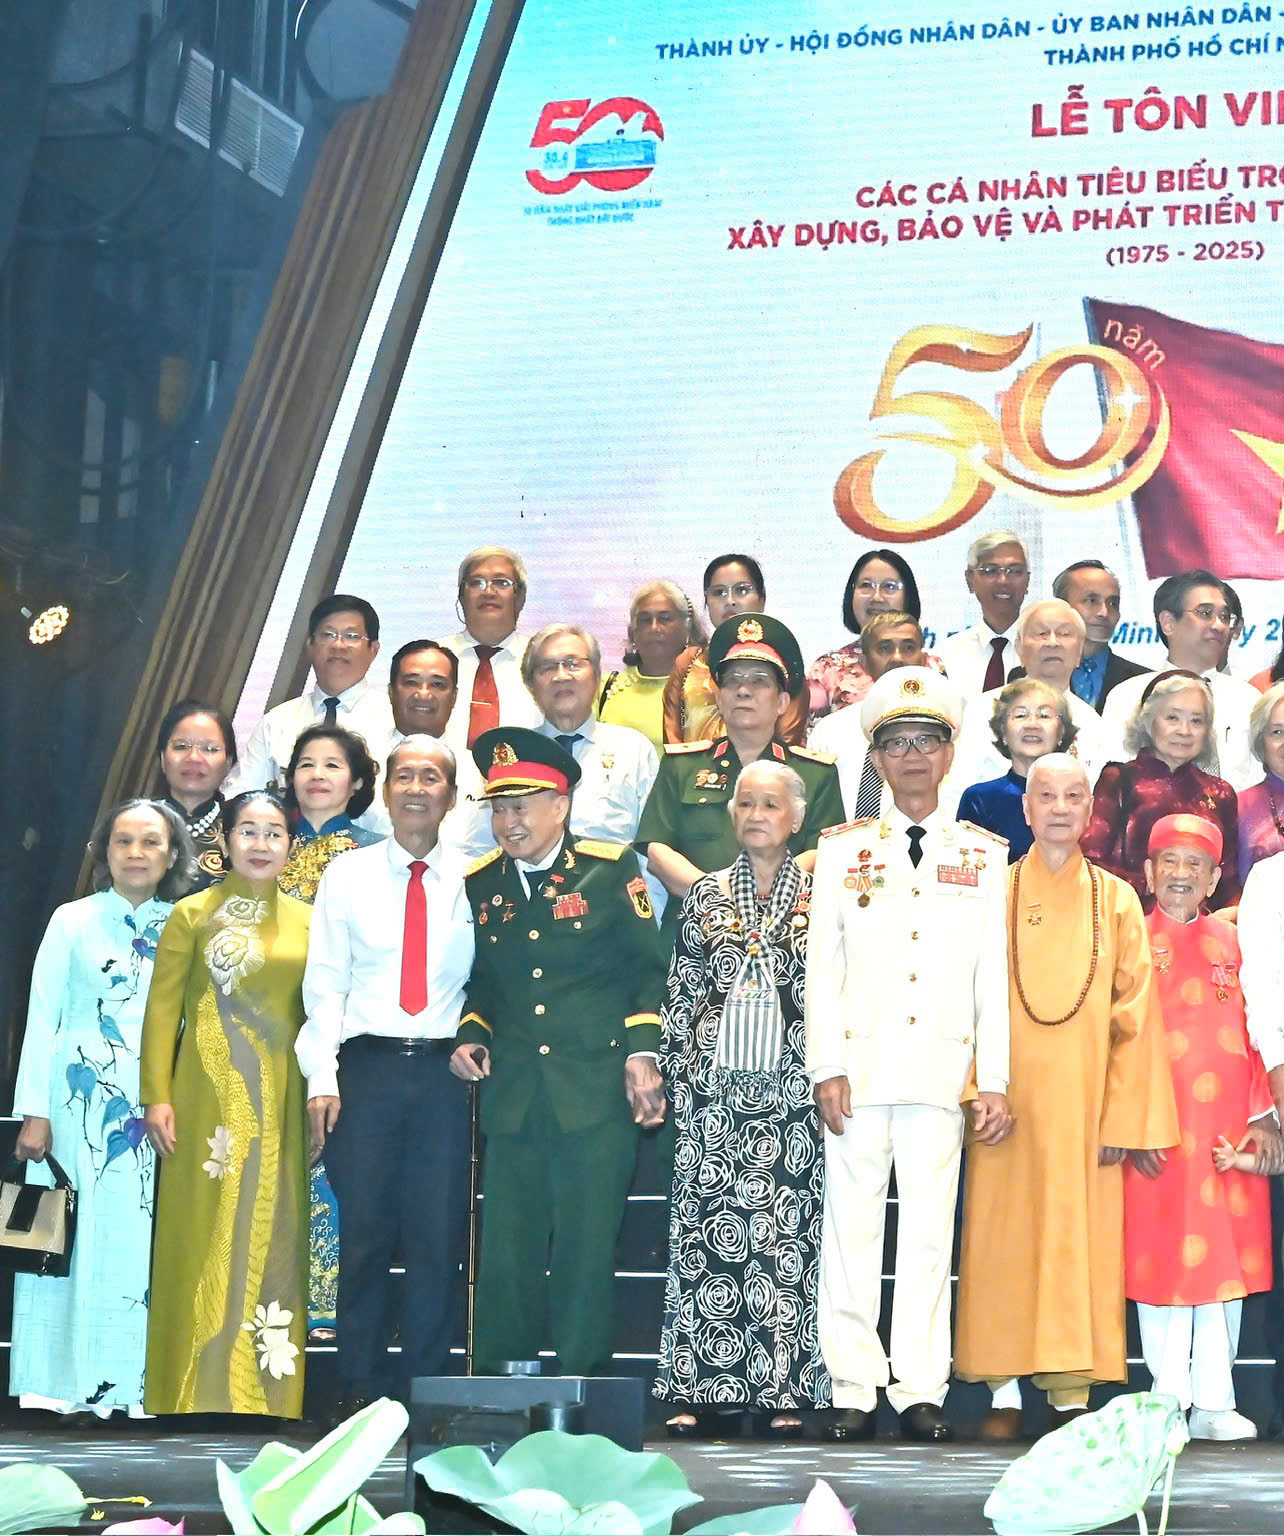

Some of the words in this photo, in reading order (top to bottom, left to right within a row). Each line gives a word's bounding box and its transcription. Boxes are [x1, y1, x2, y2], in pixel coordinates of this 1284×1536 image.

[656, 38, 732, 59] THÀNH
[740, 33, 769, 54] ỦY
[791, 30, 829, 55] HỘI
[910, 21, 975, 44] NHÂN
[982, 18, 1030, 39] DÂN
[1052, 13, 1083, 34] ỦY
[1091, 14, 1139, 32] BAN
[1147, 6, 1214, 28] NHÂN
[1222, 2, 1271, 24] DÂN
[1044, 44, 1125, 65] THÀNH
[1132, 38, 1181, 61] PHỐ
[1229, 33, 1270, 55] CHÍ
[1031, 84, 1089, 138] LỄ
[1104, 86, 1207, 133] TÔN
[856, 180, 917, 208] CÁC
[927, 176, 968, 204] CÁ
[978, 171, 1067, 202] NHÂN
[1077, 166, 1146, 196] TIÊU
[728, 219, 785, 250] XÂY
[795, 220, 888, 251] DỰNG,
[898, 209, 964, 241] BẢO
[973, 207, 1012, 241] VỆ
[1022, 205, 1063, 233] VÀ
[1072, 201, 1154, 231] PHÁT
[1106, 244, 1169, 267] (1975
[1193, 241, 1264, 261] 2025)
[833, 322, 1170, 544] 50
[1103, 319, 1166, 371] năm
